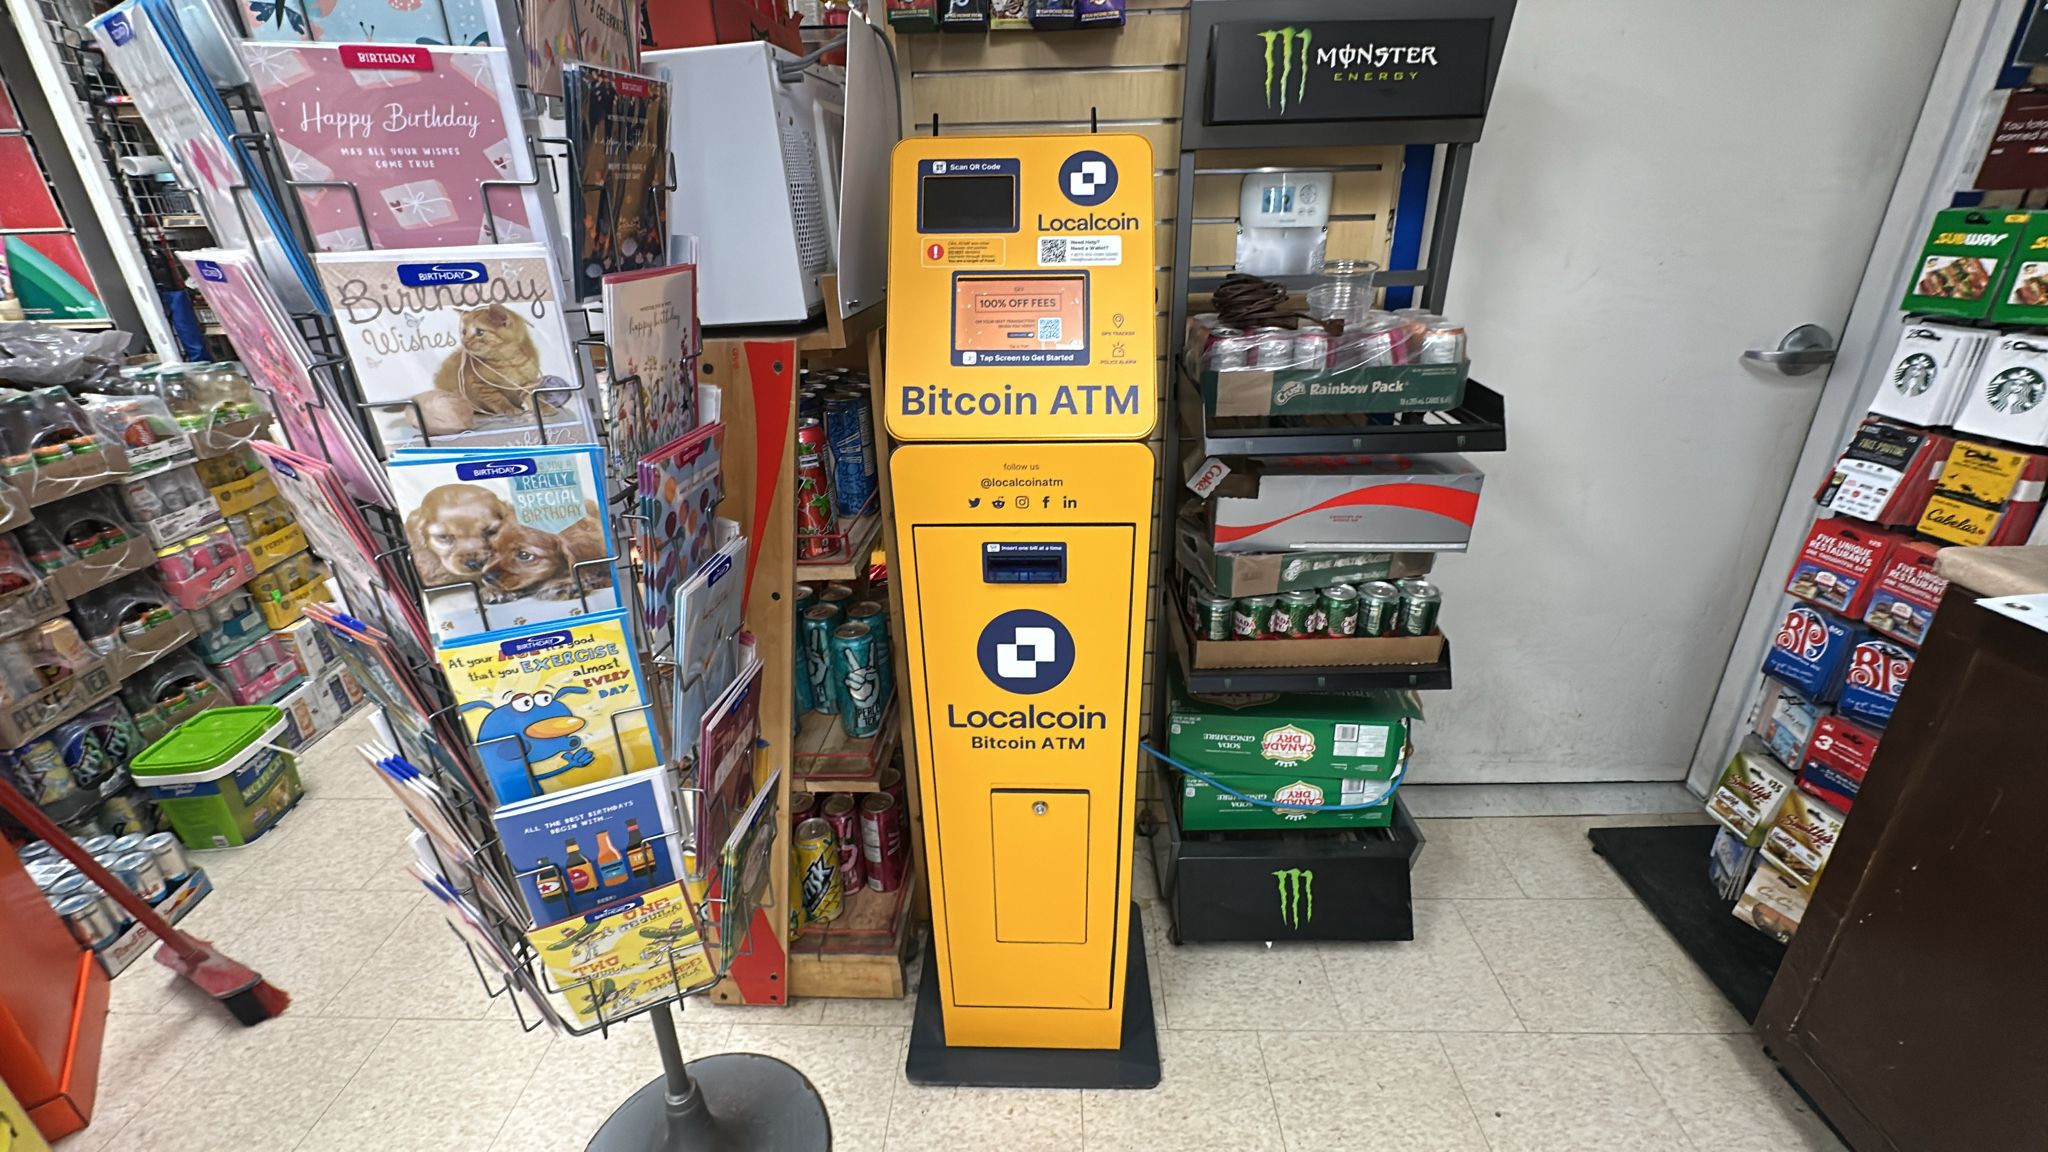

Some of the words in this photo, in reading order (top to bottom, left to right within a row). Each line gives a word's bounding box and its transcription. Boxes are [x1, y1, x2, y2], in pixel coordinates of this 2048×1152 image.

[357, 52, 417, 65] BIRTHDAY
[1333, 71, 1419, 82] ENERGY
[299, 101, 375, 139] Happy
[383, 102, 481, 138] Birthday
[340, 147, 363, 156] MAY
[368, 147, 388, 156] ALL
[391, 147, 418, 156] YOUR
[422, 147, 461, 156] WISHES
[375, 160, 403, 169] COME
[408, 160, 436, 169] TRUE
[950, 163, 968, 171] Scan
[969, 163, 980, 171] QR
[982, 162, 1001, 171] Code
[1038, 212, 1140, 232] Localcoin
[1934, 233, 2009, 246] SUBWAY
[418, 271, 466, 282] BIRTHDAY
[979, 299, 1007, 308] 100%
[1008, 299, 1029, 308] OFF
[1031, 298, 1056, 308] FEES
[362, 326, 457, 356] Wishes
[1309, 382, 1369, 396] Rainbow
[1371, 380, 1404, 393] Pack
[901, 384, 1037, 416] Bitcoin
[1049, 385, 1139, 415] ATM
[473, 466, 517, 477] BIRTHDAY
[1003, 463, 1024, 471] follow
[523, 474, 569, 491] REALLY
[980, 477, 1063, 489] @localcoinatm
[1194, 464, 1223, 492] Coke
[518, 491, 578, 510] SPECIAL
[522, 505, 582, 524] BIRTHDAY
[1808, 539, 1873, 567] RESTAURANTS
[1816, 533, 1839, 545] FIVE
[1839, 538, 1873, 558] UNIQUE
[1896, 562, 1916, 575] FIVE
[1889, 569, 1949, 595] RESTAURANT
[516, 639, 554, 651] BIRTHDAY
[568, 634, 595, 649] good
[448, 658, 465, 669] At
[467, 655, 492, 668] your
[468, 671, 496, 683] that
[498, 667, 519, 679] you
[520, 643, 619, 674] EXERCISE
[572, 657, 621, 678] almost
[583, 669, 631, 688] EVERY
[599, 684, 630, 699] DAY
[948, 704, 1107, 730] Localcoin
[971, 736, 1036, 750] Bitcoin
[1041, 737, 1086, 750] ATM
[1203, 733, 1256, 743] GINGEMBRE
[1276, 733, 1301, 744] DRY
[1814, 735, 1834, 750] 3
[1217, 742, 1241, 750] SODA
[1262, 741, 1315, 752] CANADA
[1287, 790, 1311, 799] DRY
[524, 826, 541, 834] ALL
[544, 820, 562, 829] THE
[564, 815, 585, 824] BEST
[587, 800, 634, 817] BIRTHDAYS
[550, 824, 579, 835] BEGIN
[622, 896, 673, 921] ONE
[572, 955, 620, 975] TWO
